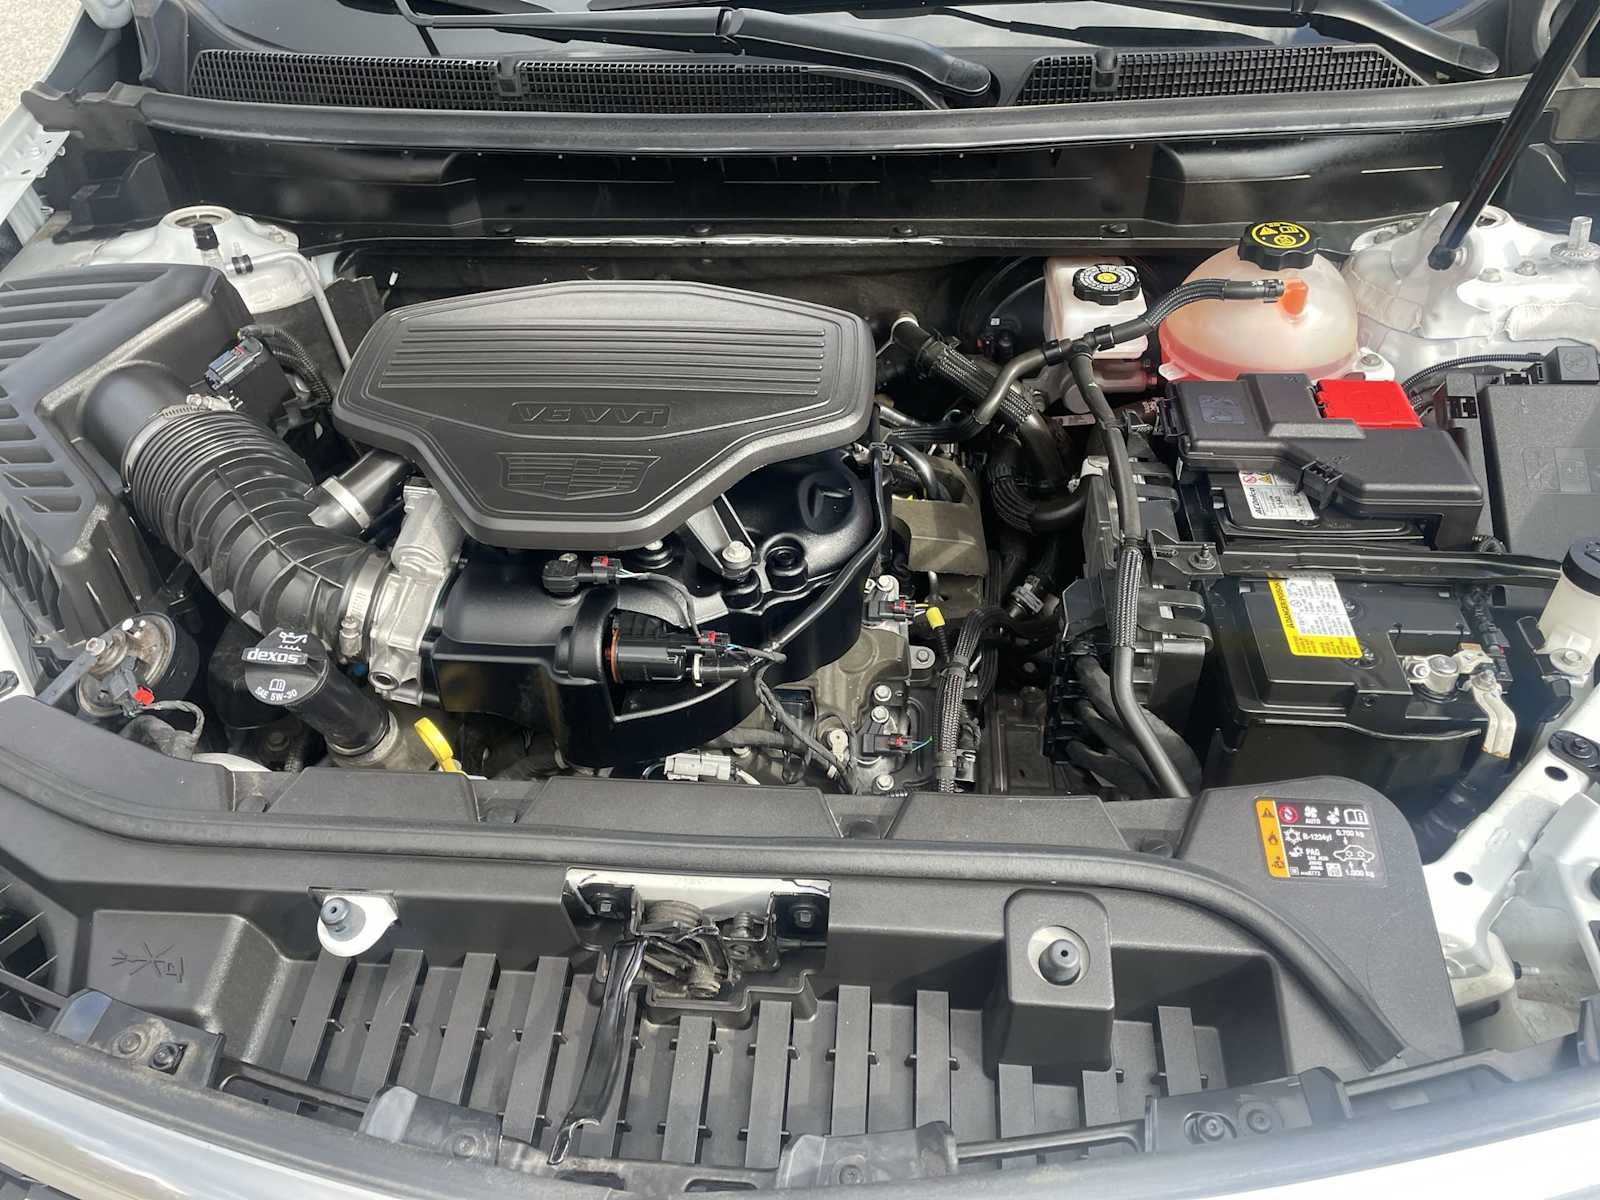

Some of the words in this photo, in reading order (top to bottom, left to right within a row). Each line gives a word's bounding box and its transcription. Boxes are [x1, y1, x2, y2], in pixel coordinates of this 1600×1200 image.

[518, 406, 571, 422] V6
[580, 407, 664, 424] VVT
[246, 648, 302, 664] dexos
